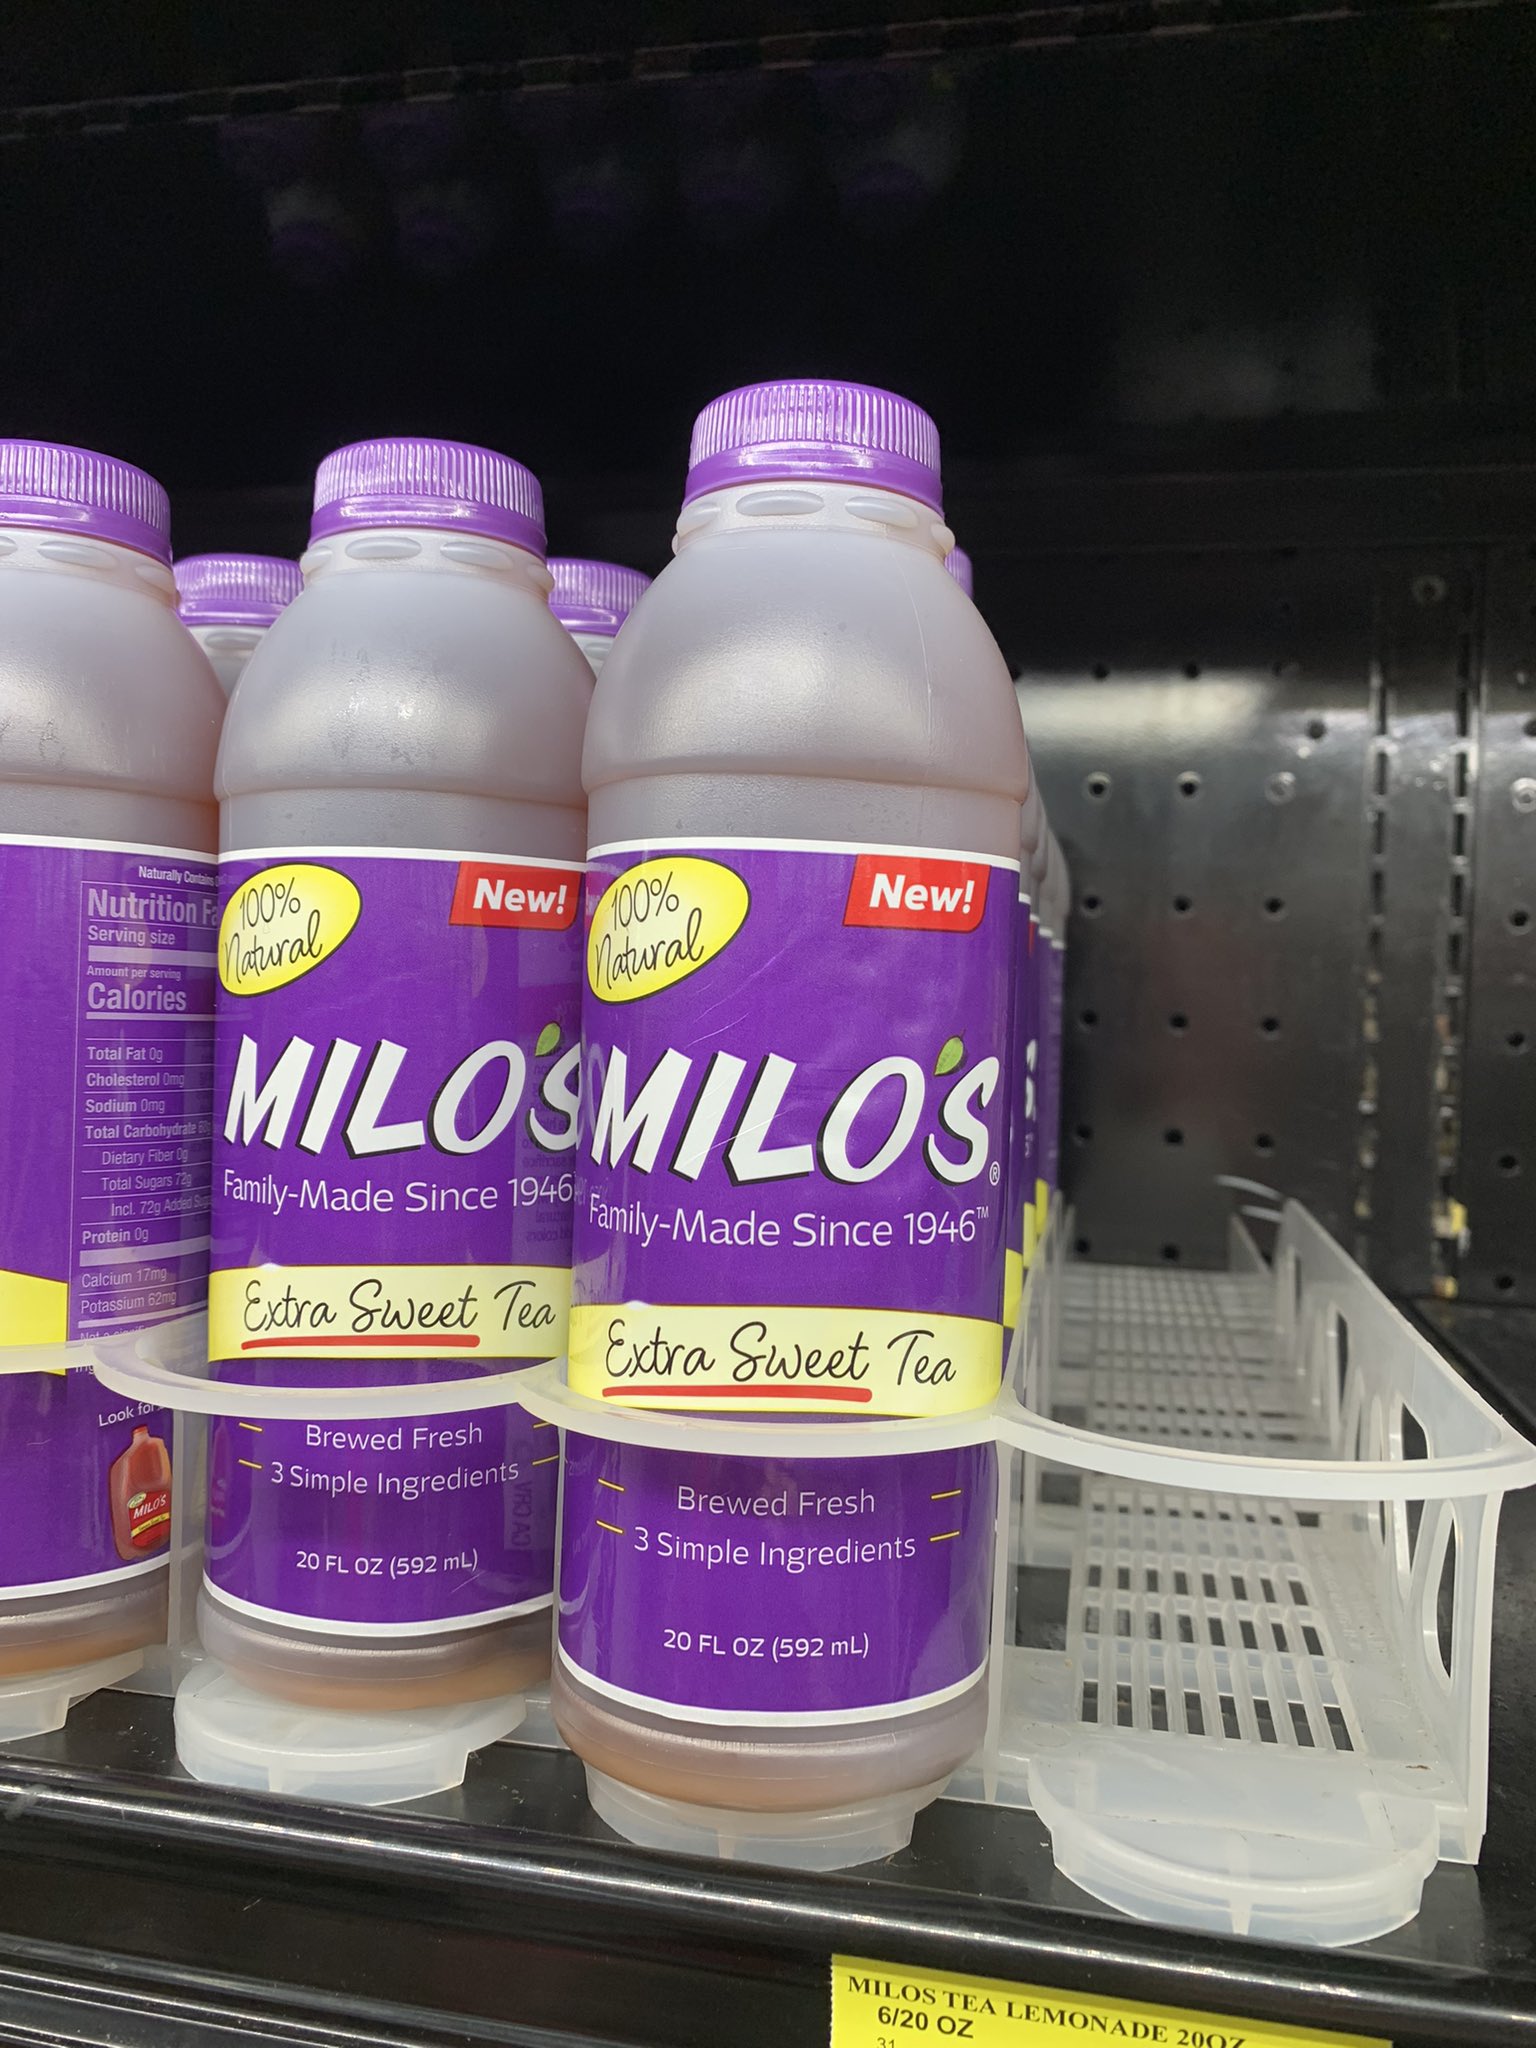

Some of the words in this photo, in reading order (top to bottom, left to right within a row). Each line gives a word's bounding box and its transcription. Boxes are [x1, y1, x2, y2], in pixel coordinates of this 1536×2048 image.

[139, 865, 182, 884] Naturally
[88, 888, 197, 924] Nutrition
[239, 877, 301, 930] 100%
[473, 878, 567, 915] New!
[610, 871, 679, 930] 100%
[868, 873, 974, 914] New!
[88, 925, 146, 946] Serving
[150, 928, 176, 945] size
[223, 909, 323, 984] Natural
[595, 907, 704, 990] Natural
[87, 965, 129, 978] Amount
[131, 968, 147, 979] per
[150, 968, 181, 981] serving
[87, 982, 187, 1011] Calories
[87, 1046, 122, 1060] Total
[126, 1047, 146, 1060] Fat
[149, 1047, 163, 1063] 0g
[87, 1072, 160, 1087] Cholesterol
[163, 1072, 184, 1088] 0mg
[85, 1099, 137, 1113] Sodium
[140, 1098, 165, 1114] 0mg
[85, 1124, 120, 1139] Total
[124, 1119, 196, 1138] Carbohydrate
[102, 1151, 144, 1166] Dietary
[148, 1149, 174, 1163] Fiber
[102, 1176, 131, 1191] Total
[135, 1174, 173, 1191] Sugars
[223, 1169, 394, 1215] Family-Made
[405, 1181, 498, 1213] Since
[508, 1173, 573, 1207] 1946
[111, 1202, 135, 1216] Incl.
[140, 1201, 161, 1216] 72g
[589, 1192, 781, 1247] Family-Made
[792, 1212, 893, 1247] Since
[82, 1229, 131, 1244] Protein
[134, 1227, 149, 1242] 0g
[81, 1272, 132, 1288] Calcium
[136, 1267, 167, 1283] 17mg
[81, 1296, 144, 1314] Potassium
[148, 1290, 177, 1307] 62mg
[243, 1279, 337, 1333] Extra
[349, 1278, 479, 1333] Sweet
[494, 1280, 556, 1331] Tea
[604, 1317, 715, 1379] Extra
[729, 1320, 870, 1383] Sweet
[887, 1329, 957, 1386] Tea
[99, 1405, 134, 1427] Look
[306, 1424, 402, 1450] Brewed
[413, 1422, 483, 1448] Fresh
[270, 1461, 284, 1484] 3
[290, 1465, 369, 1498] Simple
[378, 1461, 519, 1500] Ingredients
[677, 1486, 787, 1516] Brewed
[799, 1488, 876, 1516] Fresh
[296, 1550, 320, 1570] 20
[326, 1555, 349, 1573] FL
[354, 1557, 383, 1575] OZ
[389, 1555, 437, 1580] (592
[443, 1548, 478, 1572] mL)
[634, 1526, 649, 1552] 3
[657, 1531, 749, 1570] Simple
[760, 1535, 916, 1573] Ingredients
[663, 1628, 692, 1651] 20
[699, 1634, 726, 1655] FL
[733, 1636, 765, 1658] OZ
[772, 1636, 825, 1663] (592
[831, 1632, 870, 1658] mL)
[848, 1975, 936, 2006] MILOS
[943, 1990, 997, 2016] TEA
[1006, 2000, 1168, 2043] LEMONADE
[878, 2005, 929, 2031] 6/20
[936, 2015, 974, 2039] OZ
